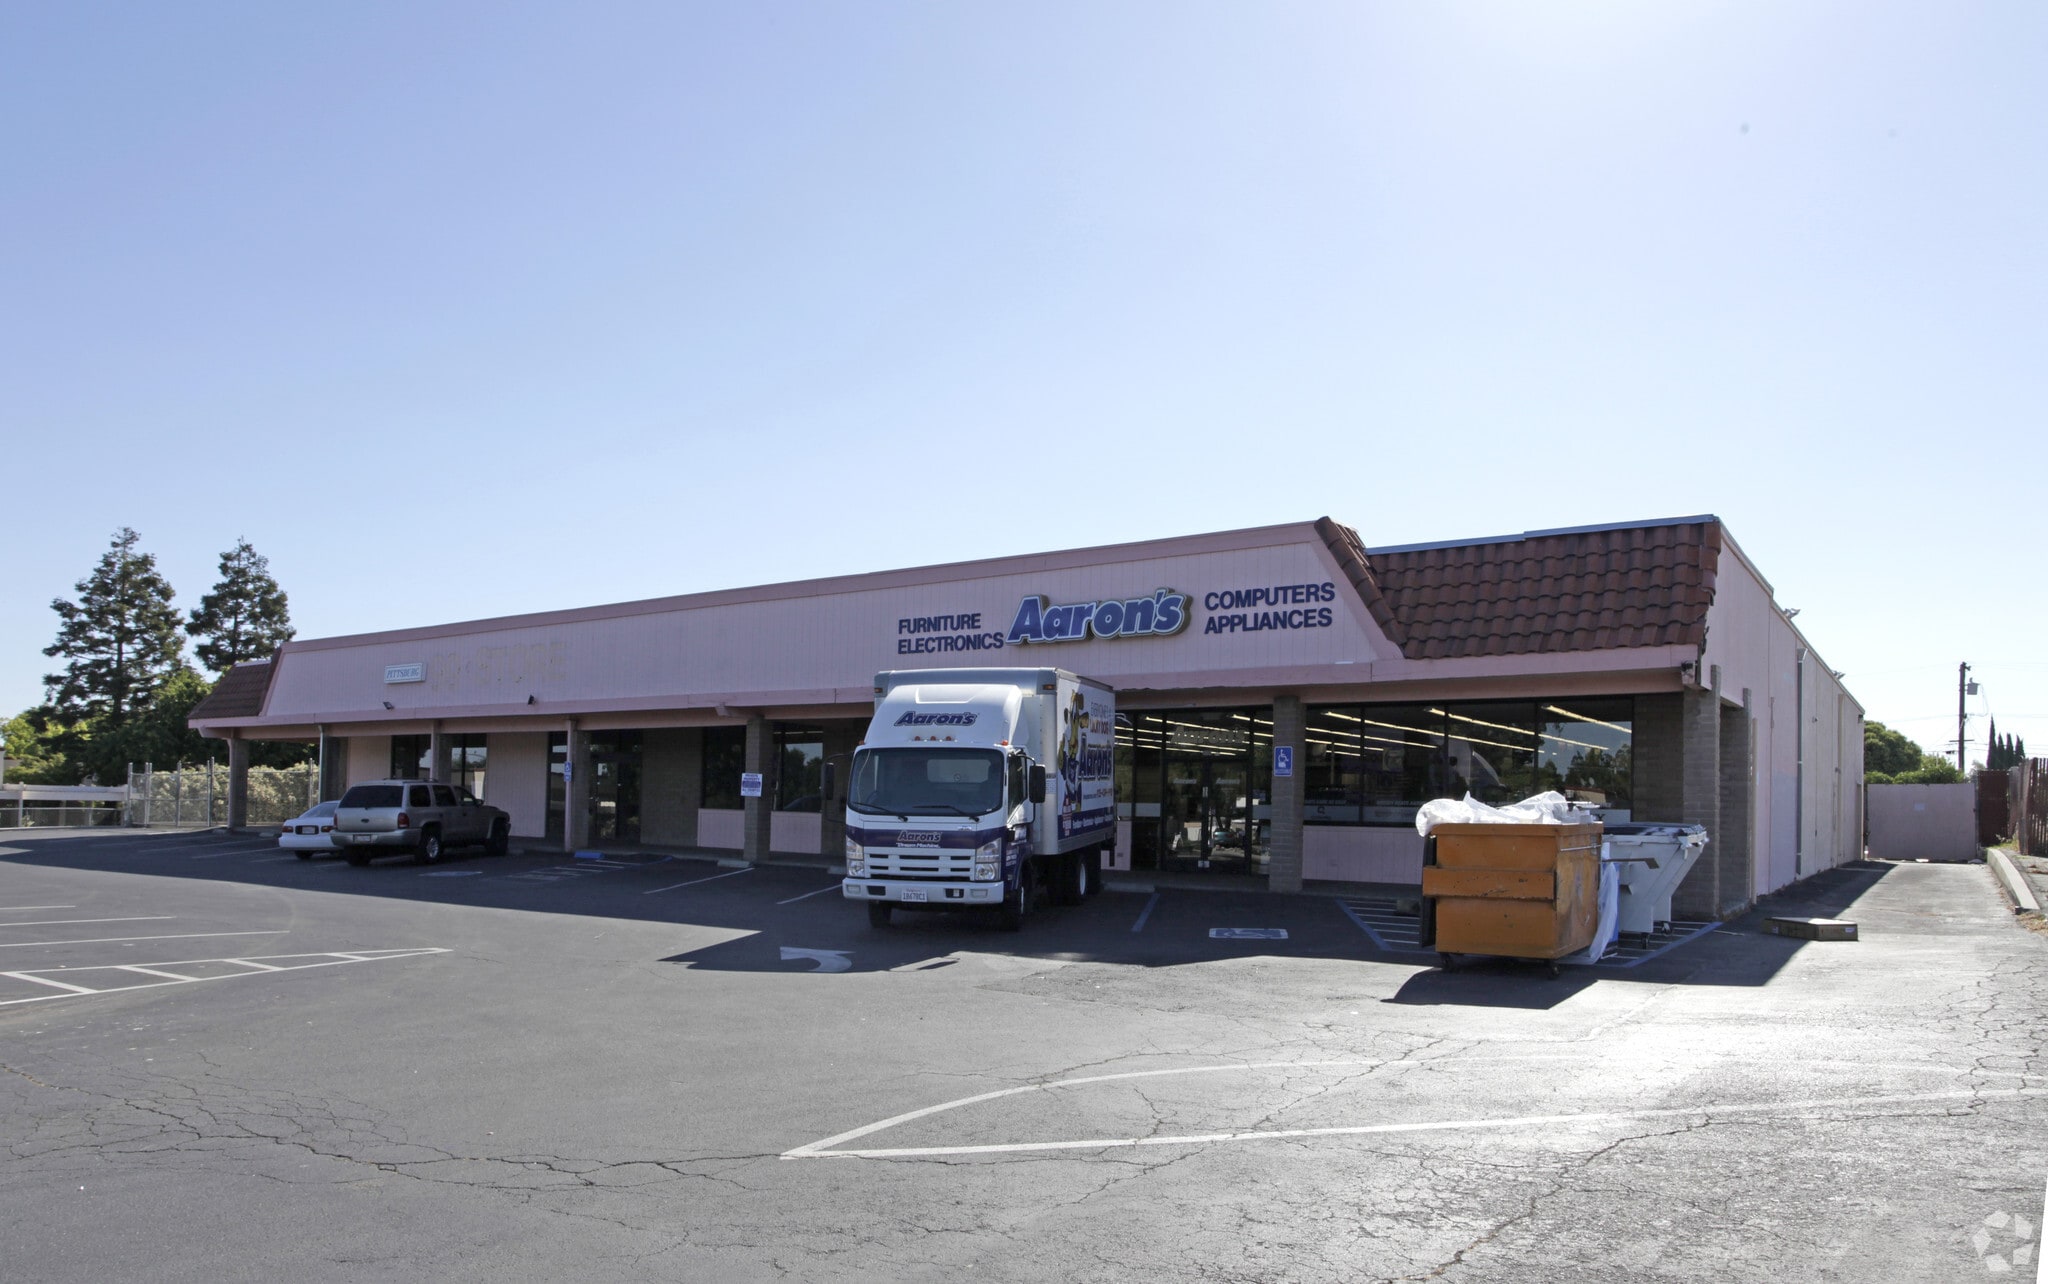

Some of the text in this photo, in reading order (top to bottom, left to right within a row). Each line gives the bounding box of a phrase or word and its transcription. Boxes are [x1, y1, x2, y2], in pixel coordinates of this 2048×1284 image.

[1204, 581, 1336, 611] COMPUTERS
[898, 613, 982, 635] FURNITURE
[1005, 587, 1193, 645] Aaron's
[1204, 607, 1334, 635] APPLIANCES
[897, 631, 1005, 655] ELECTRONICS
[893, 711, 978, 727] Aaron's
[898, 830, 941, 842] Aaron's
